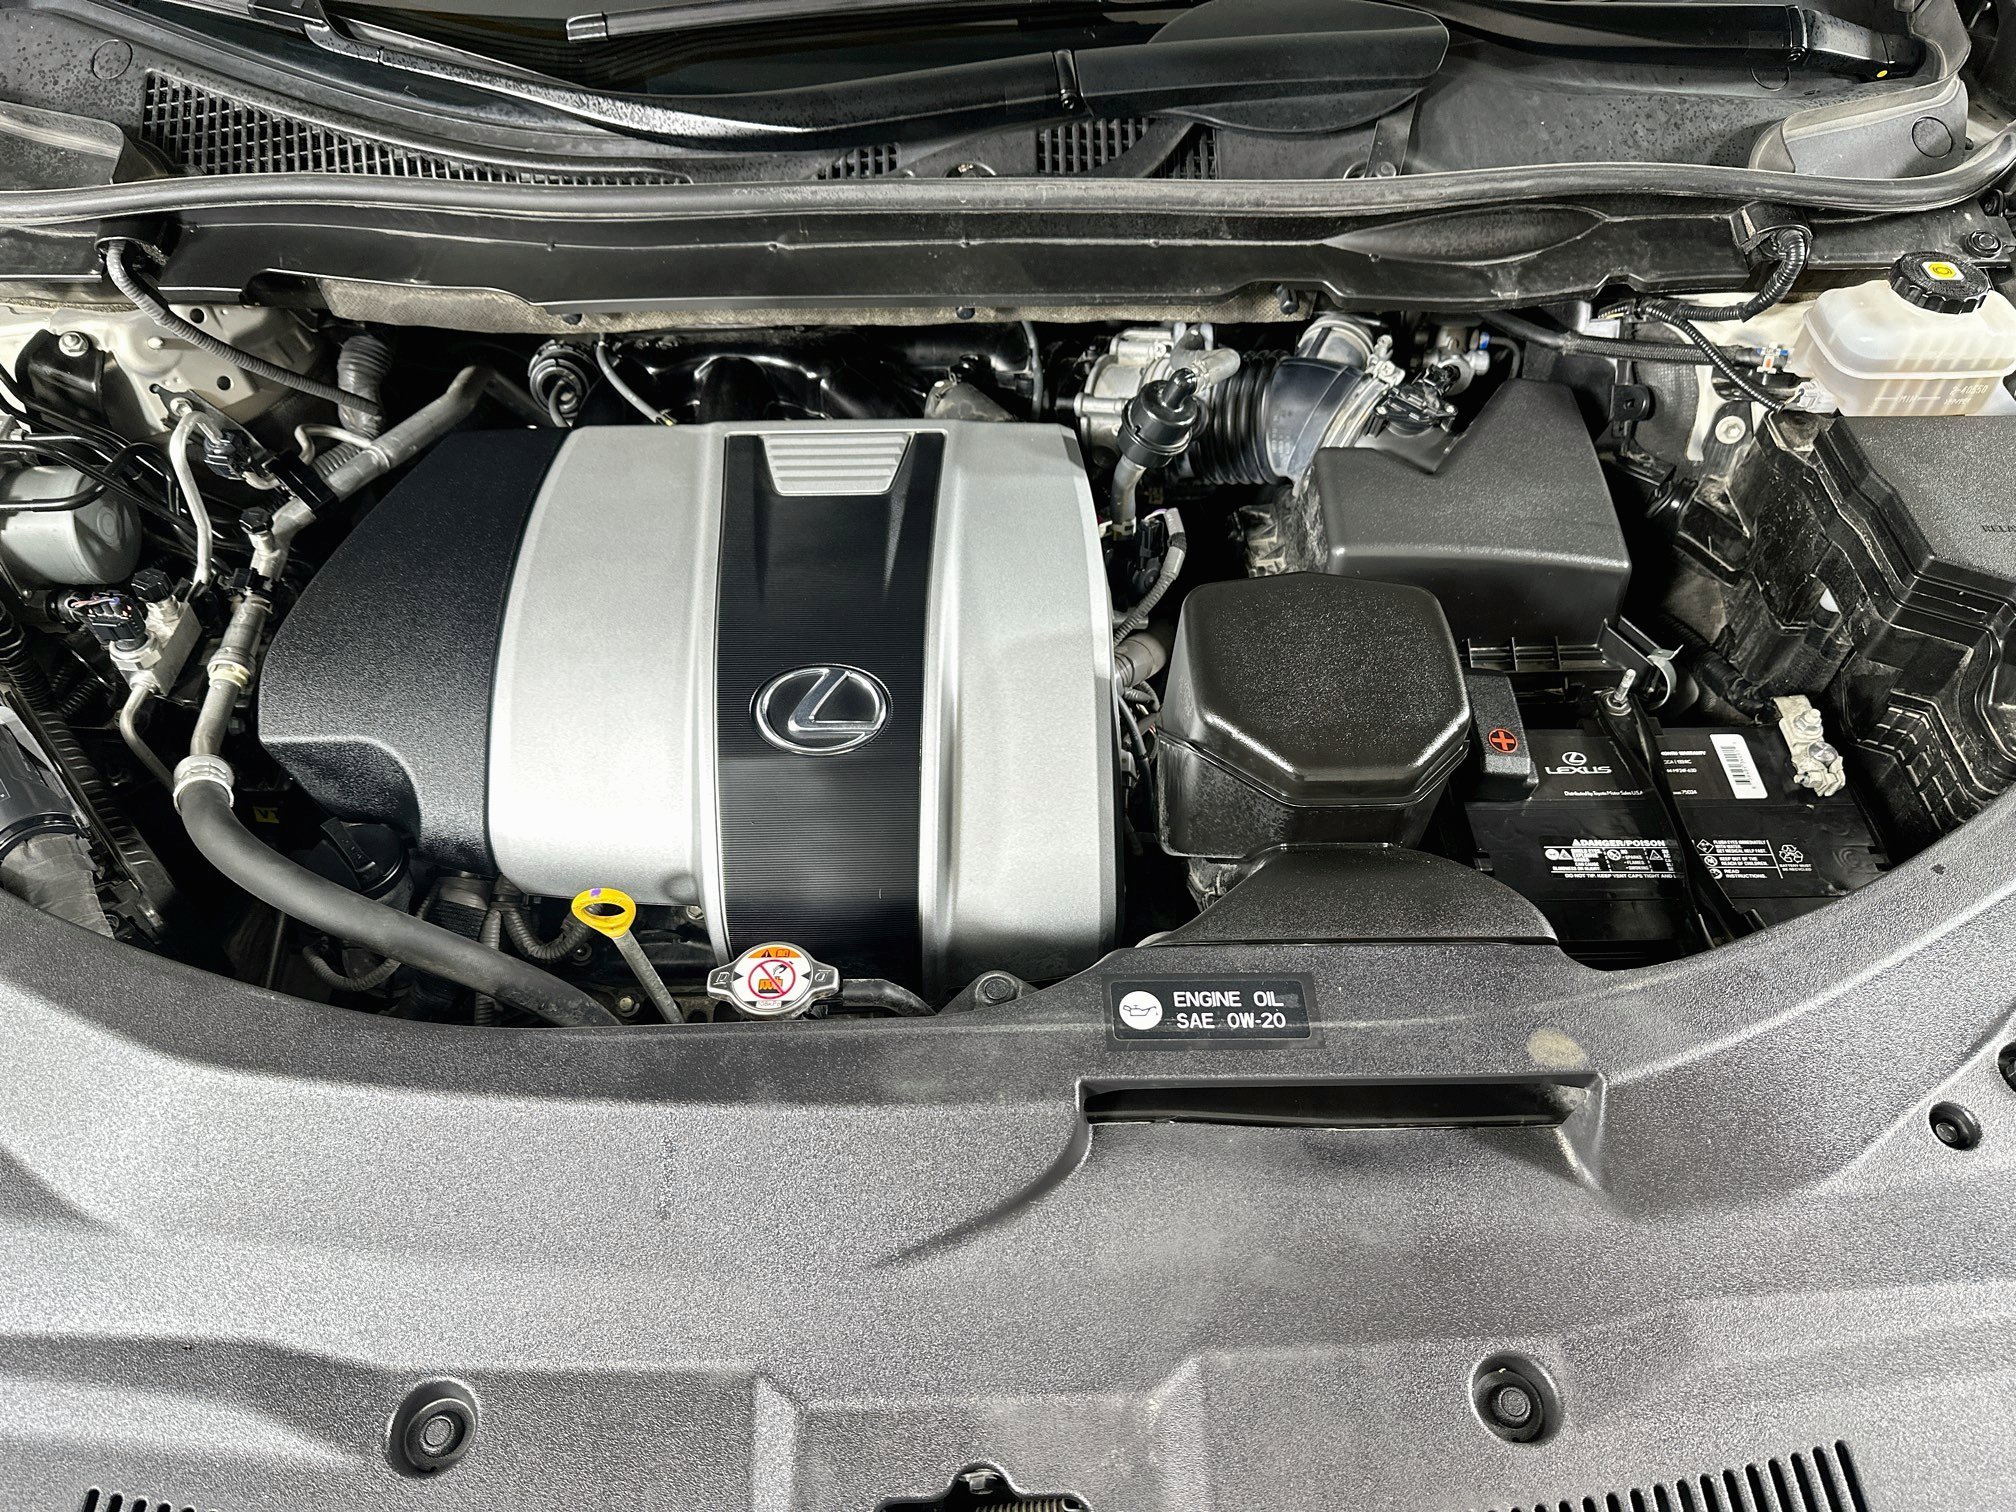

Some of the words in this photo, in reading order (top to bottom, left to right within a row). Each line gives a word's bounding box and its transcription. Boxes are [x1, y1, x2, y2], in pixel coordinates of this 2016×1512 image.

[1981, 524, 2016, 533] RELA
[1544, 766, 1612, 775] LEXUS
[1580, 839, 1666, 847] DANGER/POISON
[1173, 991, 1242, 1007] ENGINE
[1253, 991, 1284, 1007] OIL
[1176, 1013, 1215, 1028] SAE
[1227, 1013, 1286, 1028] 0W-20
